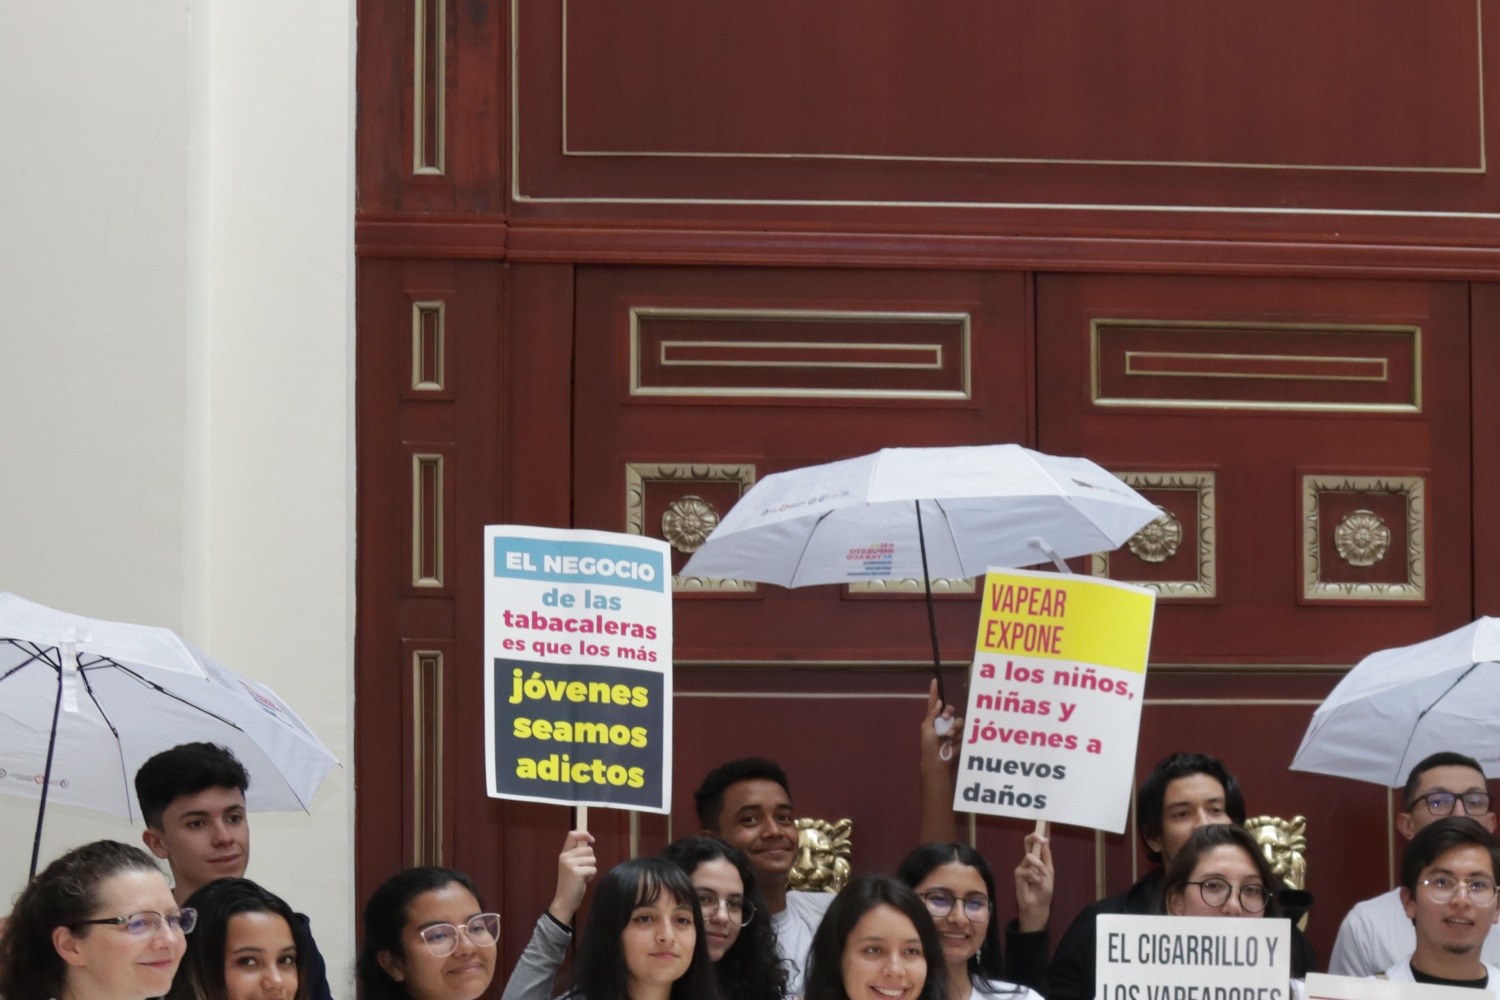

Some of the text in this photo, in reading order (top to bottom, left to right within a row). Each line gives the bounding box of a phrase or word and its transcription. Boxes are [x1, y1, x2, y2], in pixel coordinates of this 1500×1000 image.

[506, 551, 655, 582] EL NEGOCIO
[542, 588, 622, 611] de las
[992, 583, 1067, 617] VAPEAR
[503, 610, 657, 640] tabacaleras
[985, 620, 1064, 654] EXPONE
[503, 639, 657, 662] es que los más
[509, 668, 649, 708] jóvenes
[980, 661, 1134, 700] a los niños,
[976, 691, 1076, 722] niñas y
[513, 717, 648, 748] seamos
[968, 719, 1102, 754] jóvenes a
[516, 754, 644, 788] adictos
[967, 755, 1066, 780] nuevos
[963, 783, 1047, 809] daños
[1108, 933, 1278, 967] EL CIGARRILLO Y
